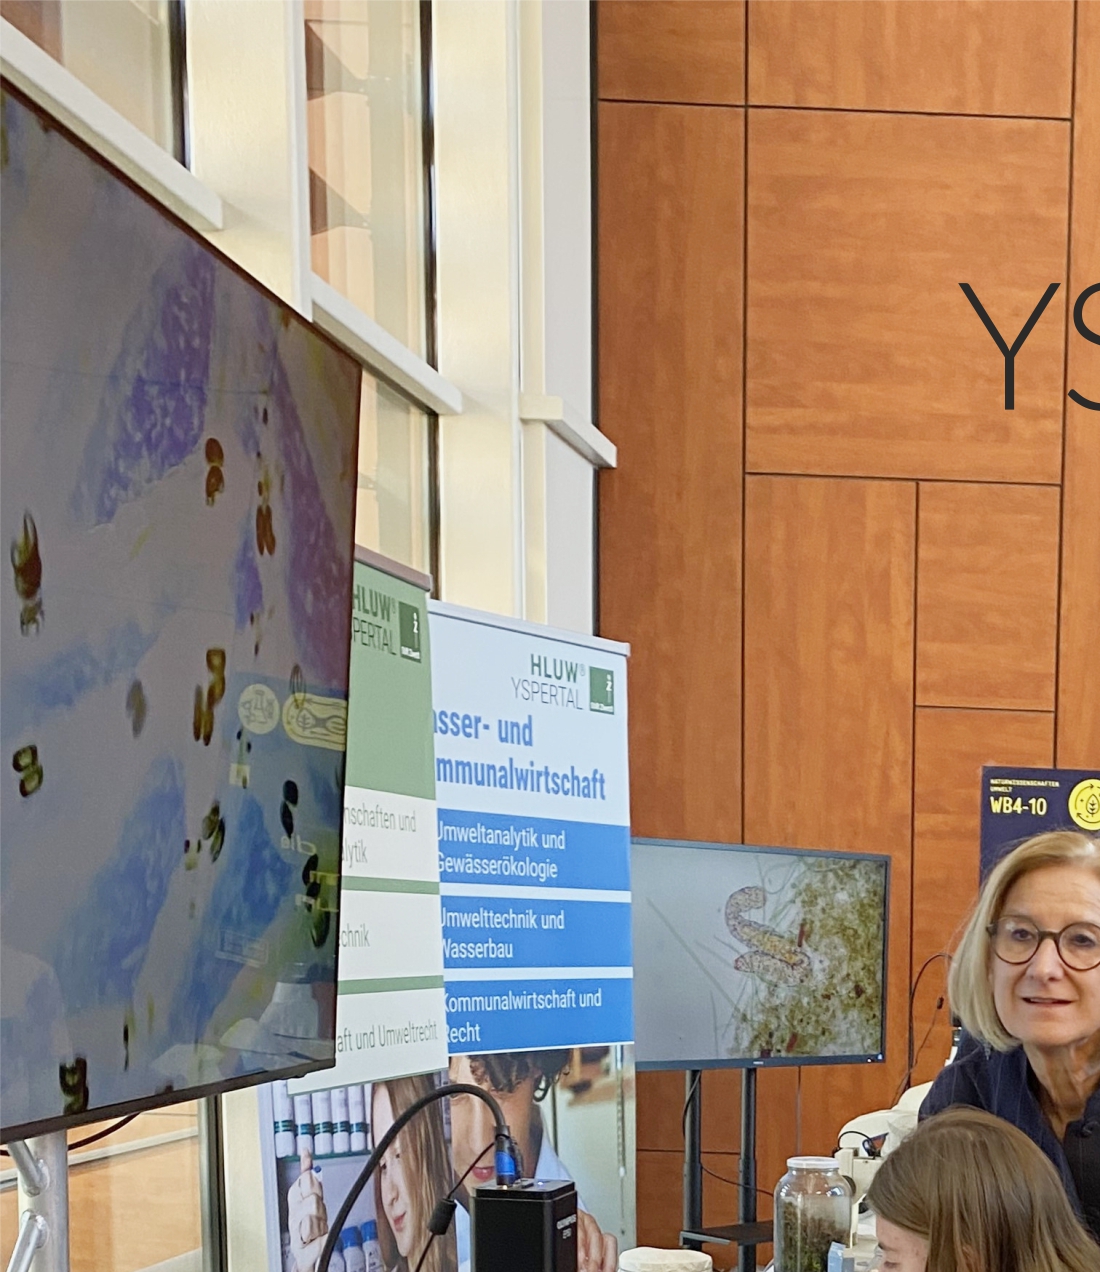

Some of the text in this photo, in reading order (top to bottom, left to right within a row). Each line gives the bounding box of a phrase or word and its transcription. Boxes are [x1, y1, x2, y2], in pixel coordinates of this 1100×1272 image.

[352, 616, 397, 656] PERTAL
[511, 676, 584, 711] YSPERTAL
[497, 714, 533, 747] und
[436, 756, 606, 801] mmunalwirtschaft
[990, 796, 1047, 816] WB4-10
[399, 810, 416, 833] und
[541, 830, 565, 850] und
[541, 909, 565, 930] und
[579, 988, 602, 1008] und
[356, 1027, 375, 1049] und
[378, 1019, 438, 1047] Umweltrecht
